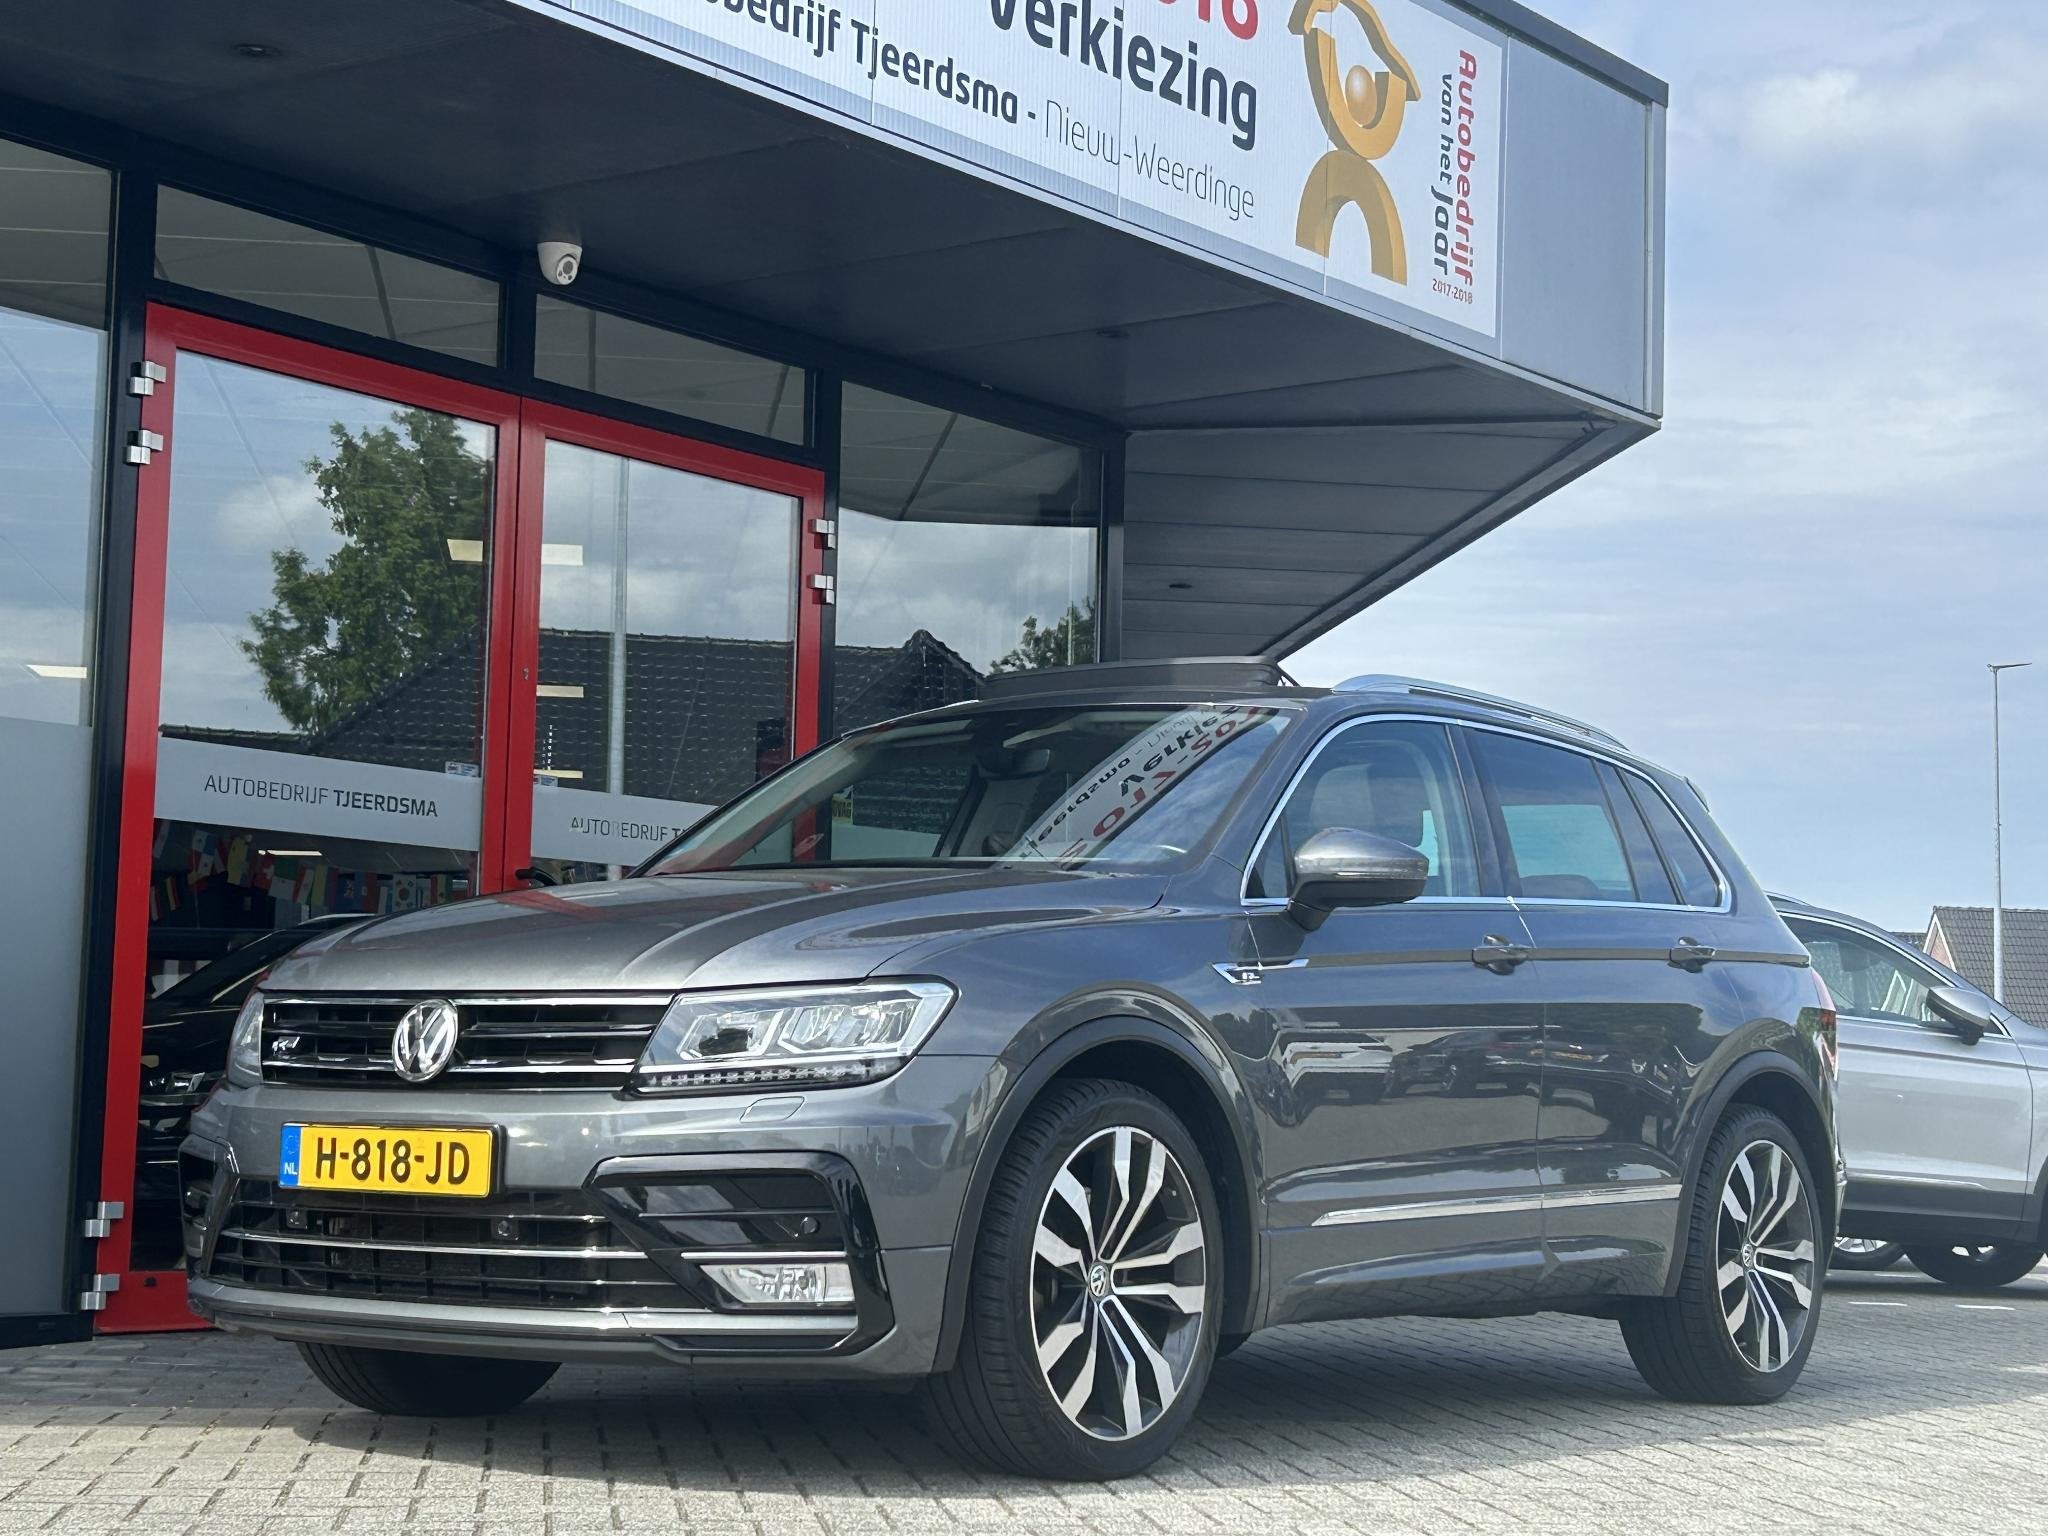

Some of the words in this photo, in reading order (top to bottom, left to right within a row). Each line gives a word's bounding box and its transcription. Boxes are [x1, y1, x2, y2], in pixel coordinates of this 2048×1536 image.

[851, 19, 1018, 125] Tjeerdsma
[1440, 73, 1453, 126] van
[1439, 133, 1455, 185] het
[1450, 49, 1478, 286] Autobedrijf
[203, 774, 329, 806] AUTOBEDRIJF
[332, 788, 439, 818] TJEERDSMA
[284, 1161, 298, 1176] NL
[314, 1136, 470, 1186] H-818-JD
